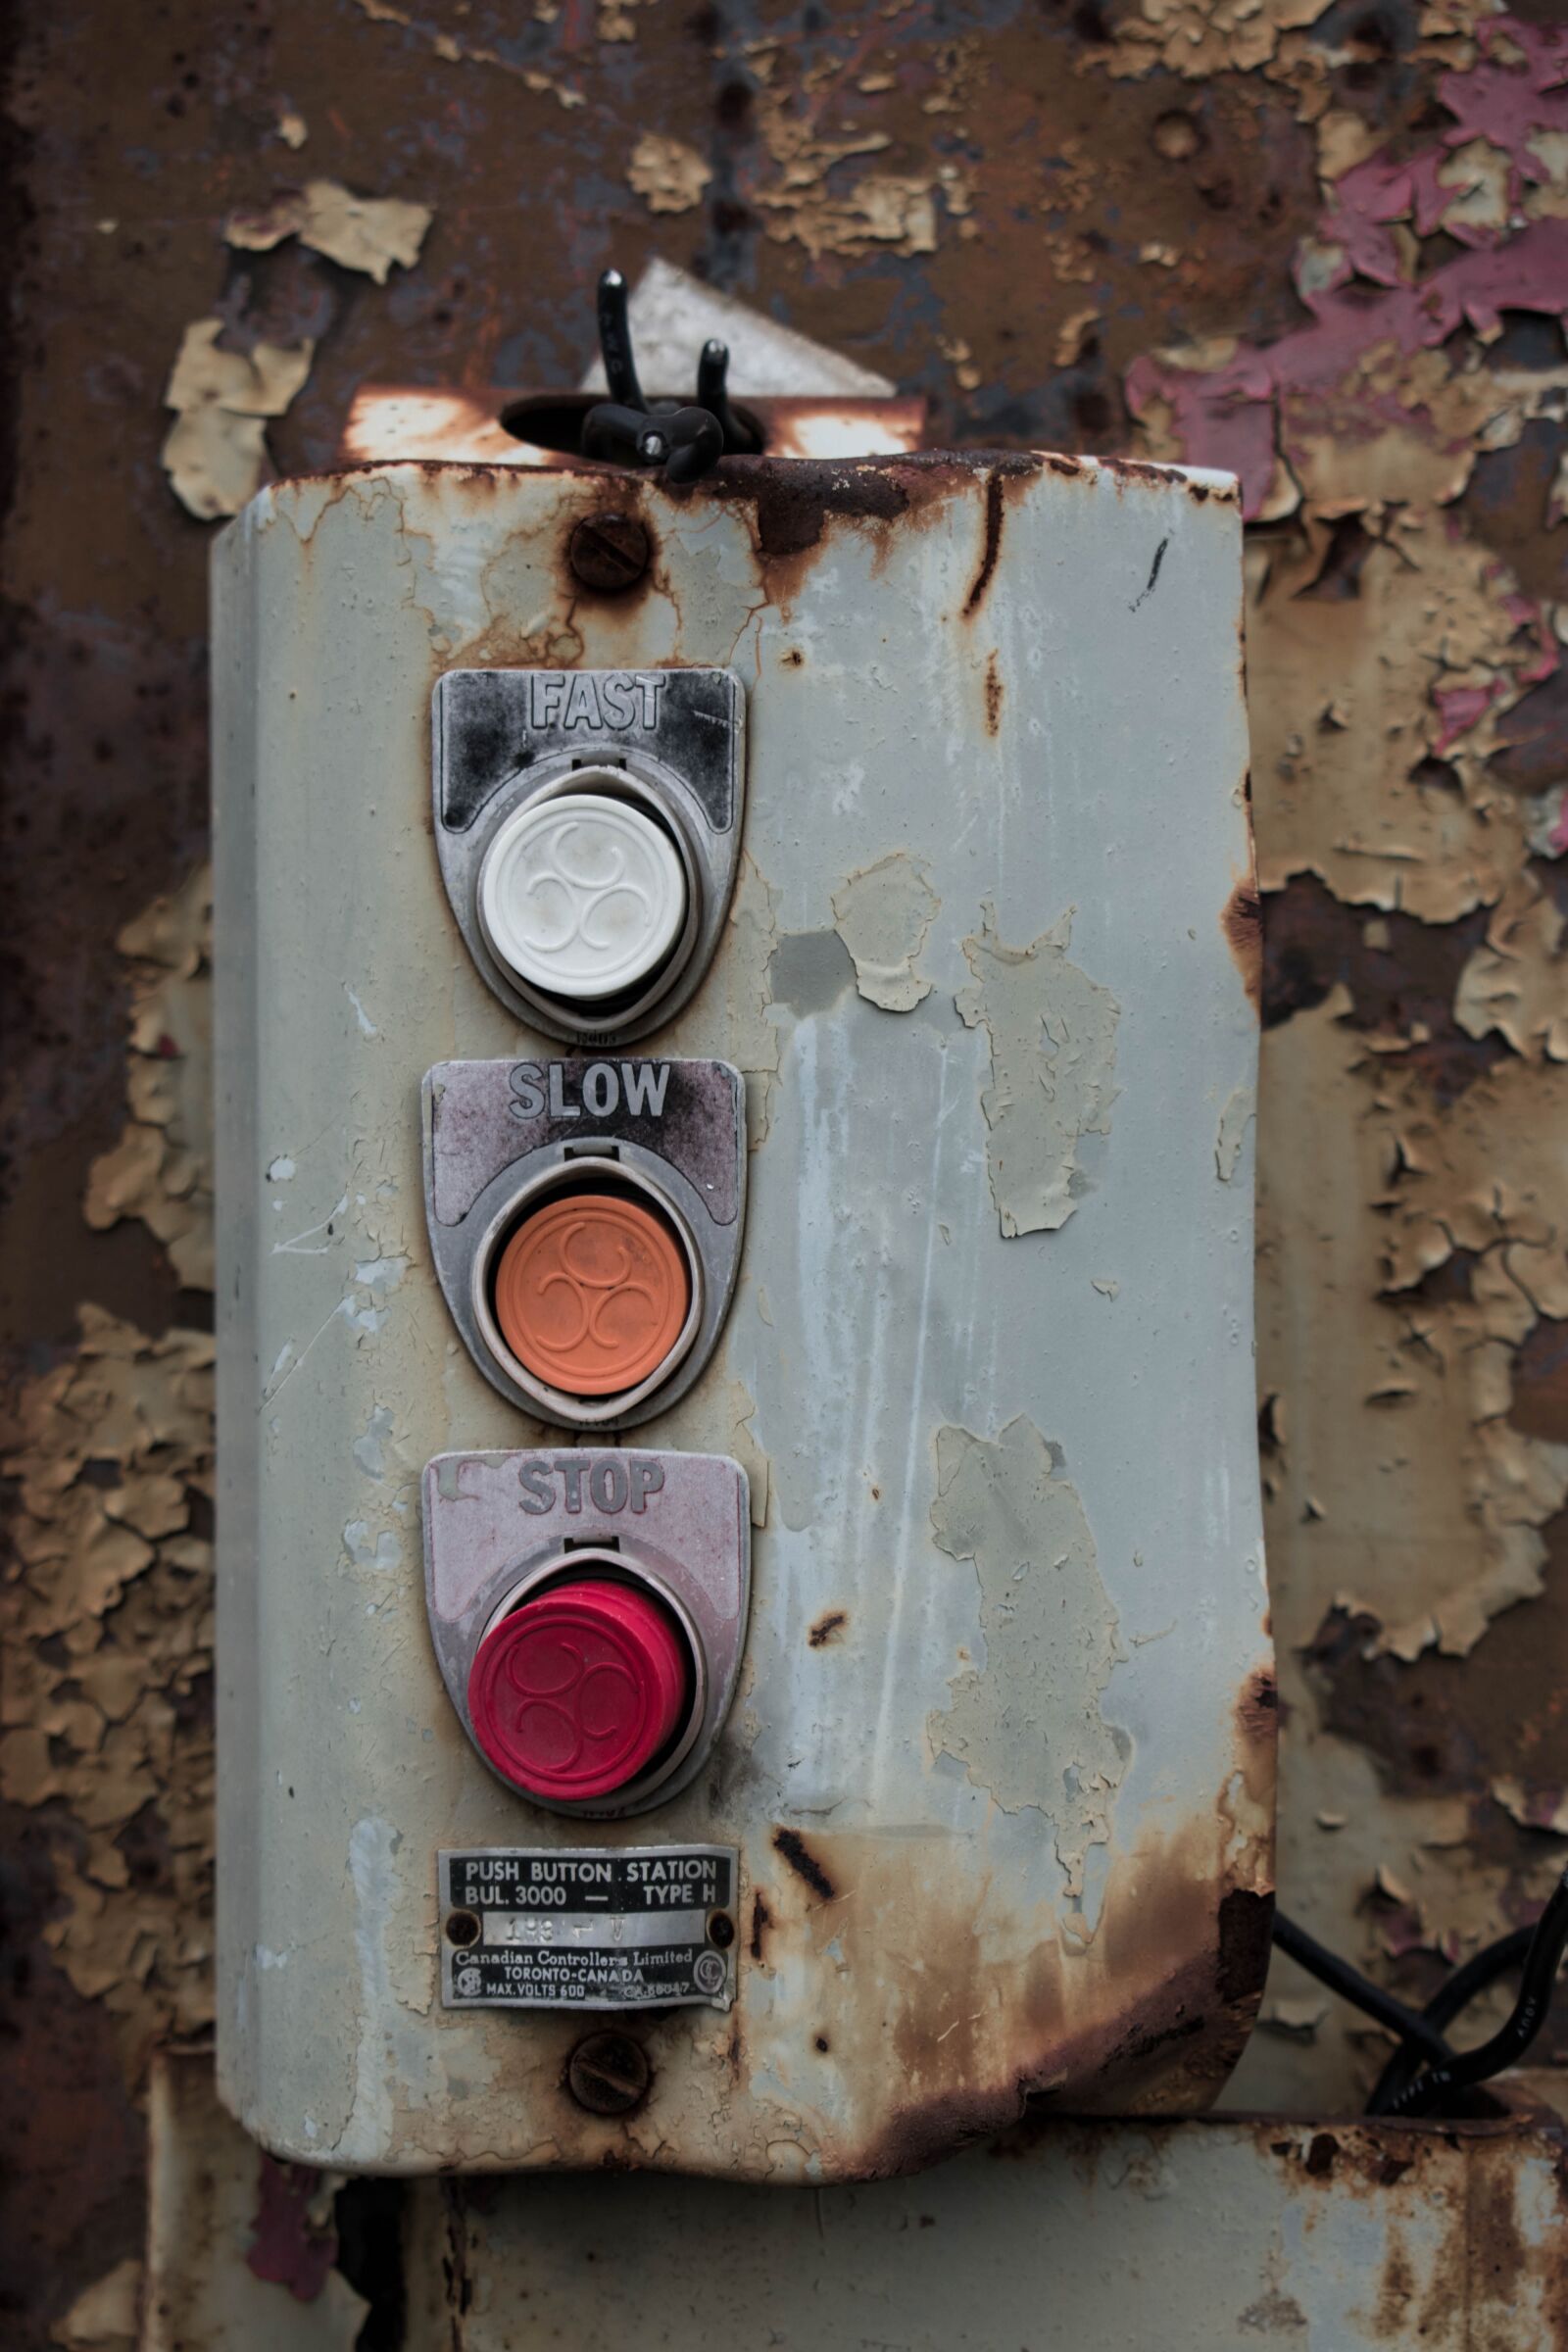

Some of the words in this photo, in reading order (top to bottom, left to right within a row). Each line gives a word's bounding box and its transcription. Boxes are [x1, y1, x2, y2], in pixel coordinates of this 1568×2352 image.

[530, 673, 665, 730] FAST
[509, 1062, 670, 1119] SLOW
[518, 1458, 665, 1515] STOP
[466, 1861, 519, 1881] PUSH
[531, 1862, 612, 1883] BUTTON
[627, 1860, 716, 1882] STATION
[466, 1886, 510, 1905] BUL.
[515, 1886, 566, 1906] 3000
[643, 1884, 693, 1904] TYPE
[703, 1884, 716, 1903] H
[456, 1949, 533, 1966] Canadian
[633, 1948, 693, 1966] Limited
[504, 1967, 645, 1983] TORONTO-CANADA
[561, 1984, 585, 1997] 600
